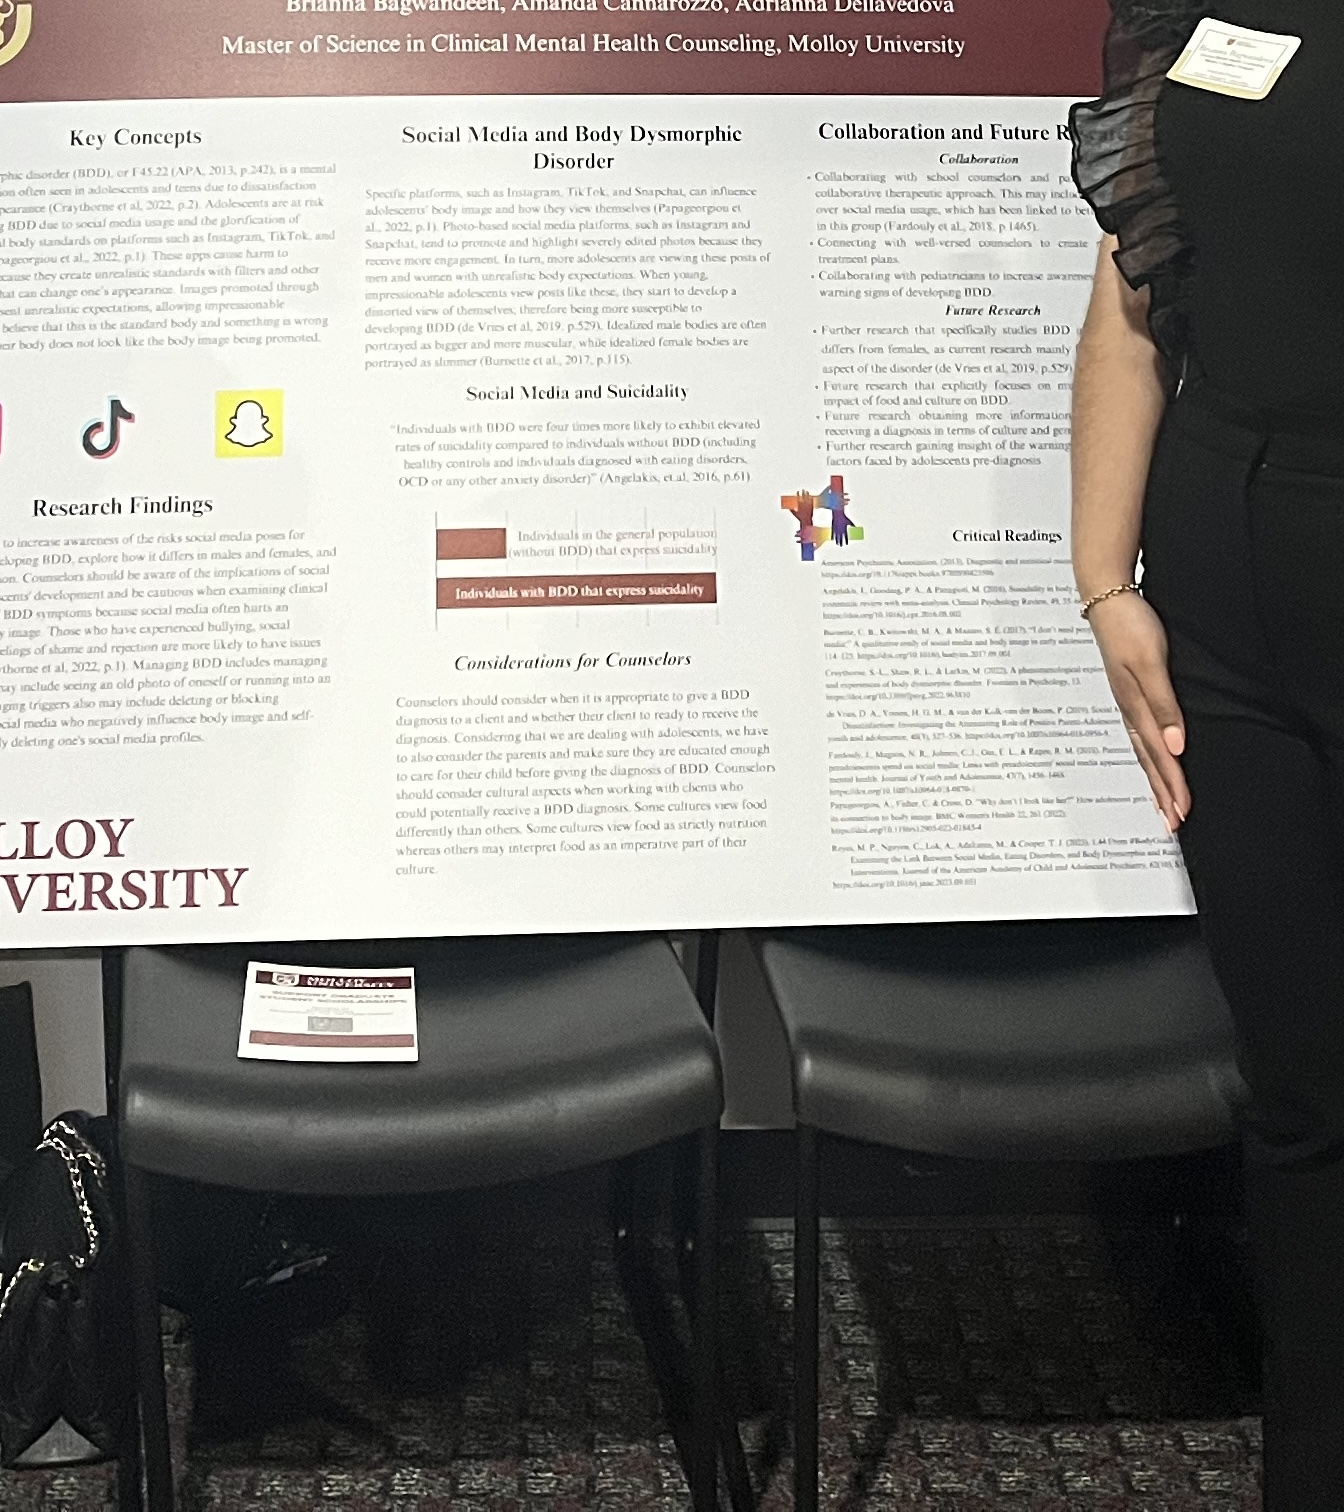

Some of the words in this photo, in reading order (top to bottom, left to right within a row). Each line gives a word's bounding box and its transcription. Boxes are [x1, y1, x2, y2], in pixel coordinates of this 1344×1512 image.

[222, 37, 293, 53] Master
[299, 35, 322, 52] of
[326, 35, 400, 52] Science
[406, 34, 425, 51] in
[431, 34, 508, 52] Clinical
[514, 34, 585, 51] Mental
[592, 34, 659, 51] Health
[665, 34, 781, 56] Counseling,
[788, 34, 858, 56] Molloy
[865, 35, 964, 57] University
[70, 129, 105, 150] Key
[113, 128, 201, 149] Concepts
[402, 127, 460, 143] Social
[468, 126, 527, 142] Media
[534, 126, 567, 142] and
[575, 125, 622, 146] Body
[630, 125, 741, 146] Dysmorphic
[818, 123, 944, 139] Collaboration
[951, 124, 983, 139] and
[989, 124, 1049, 140] Future
[533, 153, 614, 169] Disorder
[939, 153, 1018, 165] Collaboration
[944, 304, 984, 316] Future
[988, 304, 1040, 316] Research
[466, 386, 513, 400] Social
[520, 385, 569, 400] Media
[574, 384, 601, 399] and
[607, 384, 686, 402] Suicidality
[394, 443, 421, 452] rates
[423, 441, 436, 451] of
[438, 439, 492, 454] suicidality
[494, 439, 548, 452] compared
[551, 440, 563, 449] to
[565, 437, 624, 449] individuals
[626, 437, 668, 448] without
[671, 436, 700, 448] BDD
[702, 436, 756, 450] (including
[826, 456, 862, 466] factors
[864, 455, 892, 466] faced
[894, 455, 907, 468] by
[910, 455, 970, 466] adolescents
[972, 455, 1041, 468] pre-diagnosis
[33, 497, 121, 517] Research
[130, 495, 212, 518] Findings
[2, 539, 14, 549] to
[16, 536, 61, 548] increase
[63, 536, 119, 547] awareness
[121, 533, 135, 545] of
[136, 533, 154, 545] the
[156, 533, 182, 544] risks
[184, 532, 216, 543] social
[218, 531, 252, 542] media
[255, 533, 285, 543] poses
[288, 528, 305, 539] for
[516, 530, 579, 542] Individuals
[581, 532, 592, 540] in
[595, 529, 612, 540] the
[615, 531, 655, 543] general
[656, 529, 717, 541] population
[952, 530, 1000, 542] Critical
[1004, 529, 1062, 544] Readings
[507, 547, 554, 559] (without
[558, 545, 592, 558] BDD)
[595, 545, 617, 556] that
[619, 547, 660, 558] express
[662, 545, 718, 557] suicidality
[455, 587, 518, 600] Individuals
[520, 586, 544, 598] with
[548, 585, 578, 597] BDD
[580, 585, 602, 597] that
[605, 587, 646, 598] express
[648, 583, 703, 598] suicidality
[454, 654, 570, 670] Considerations
[573, 653, 599, 672] for
[605, 651, 691, 668] Counselors
[395, 696, 458, 708] Counselors
[461, 694, 497, 706] should
[500, 693, 547, 706] consider
[550, 693, 579, 704] when
[582, 693, 590, 704] it
[593, 695, 602, 703] is
[604, 692, 669, 706] appropriate
[671, 692, 683, 702] to
[686, 692, 708, 705] give
[710, 692, 717, 701] a
[720, 689, 749, 701] BDD
